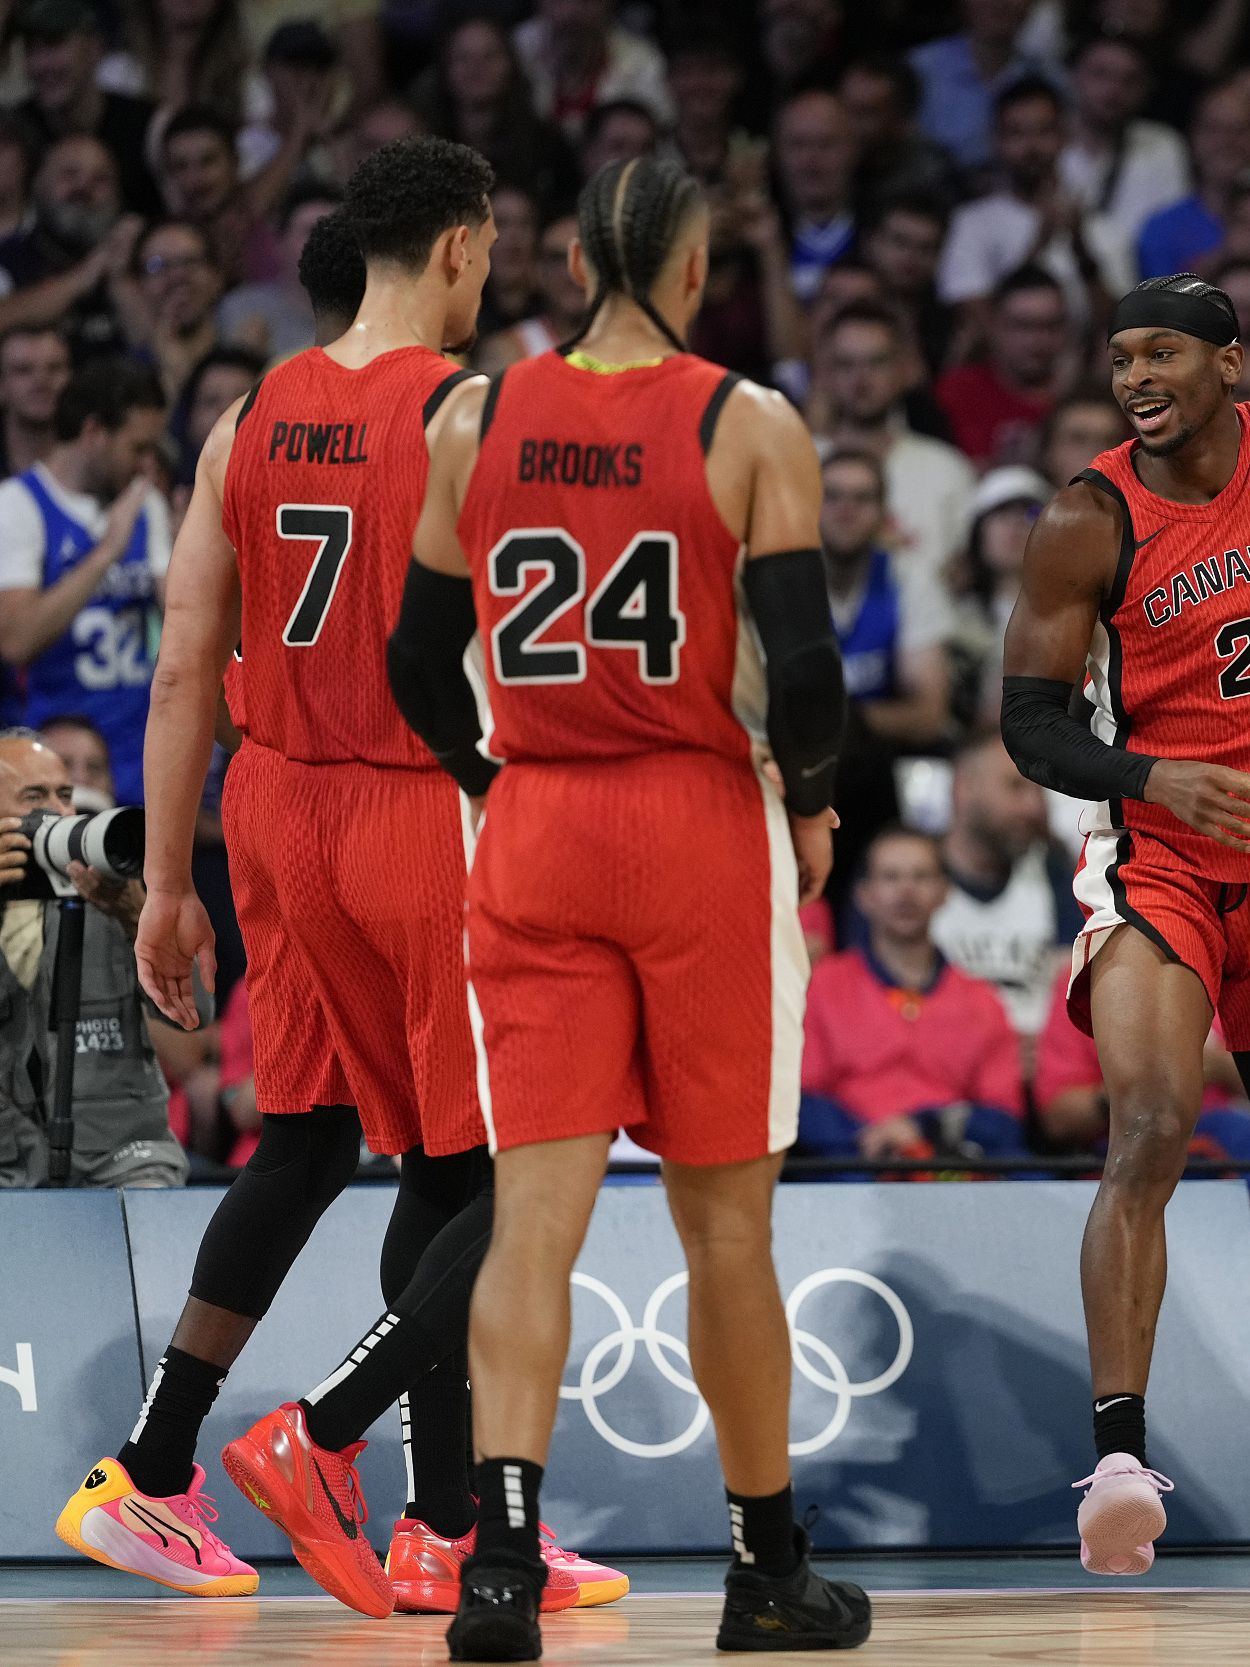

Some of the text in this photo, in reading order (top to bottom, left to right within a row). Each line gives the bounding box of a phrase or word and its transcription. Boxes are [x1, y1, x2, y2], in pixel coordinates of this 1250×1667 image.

[269, 421, 367, 464] POWELL
[518, 439, 643, 487] BROOKS
[276, 503, 353, 647] 7
[488, 527, 686, 685] 24
[75, 1032, 125, 1053] 1423
